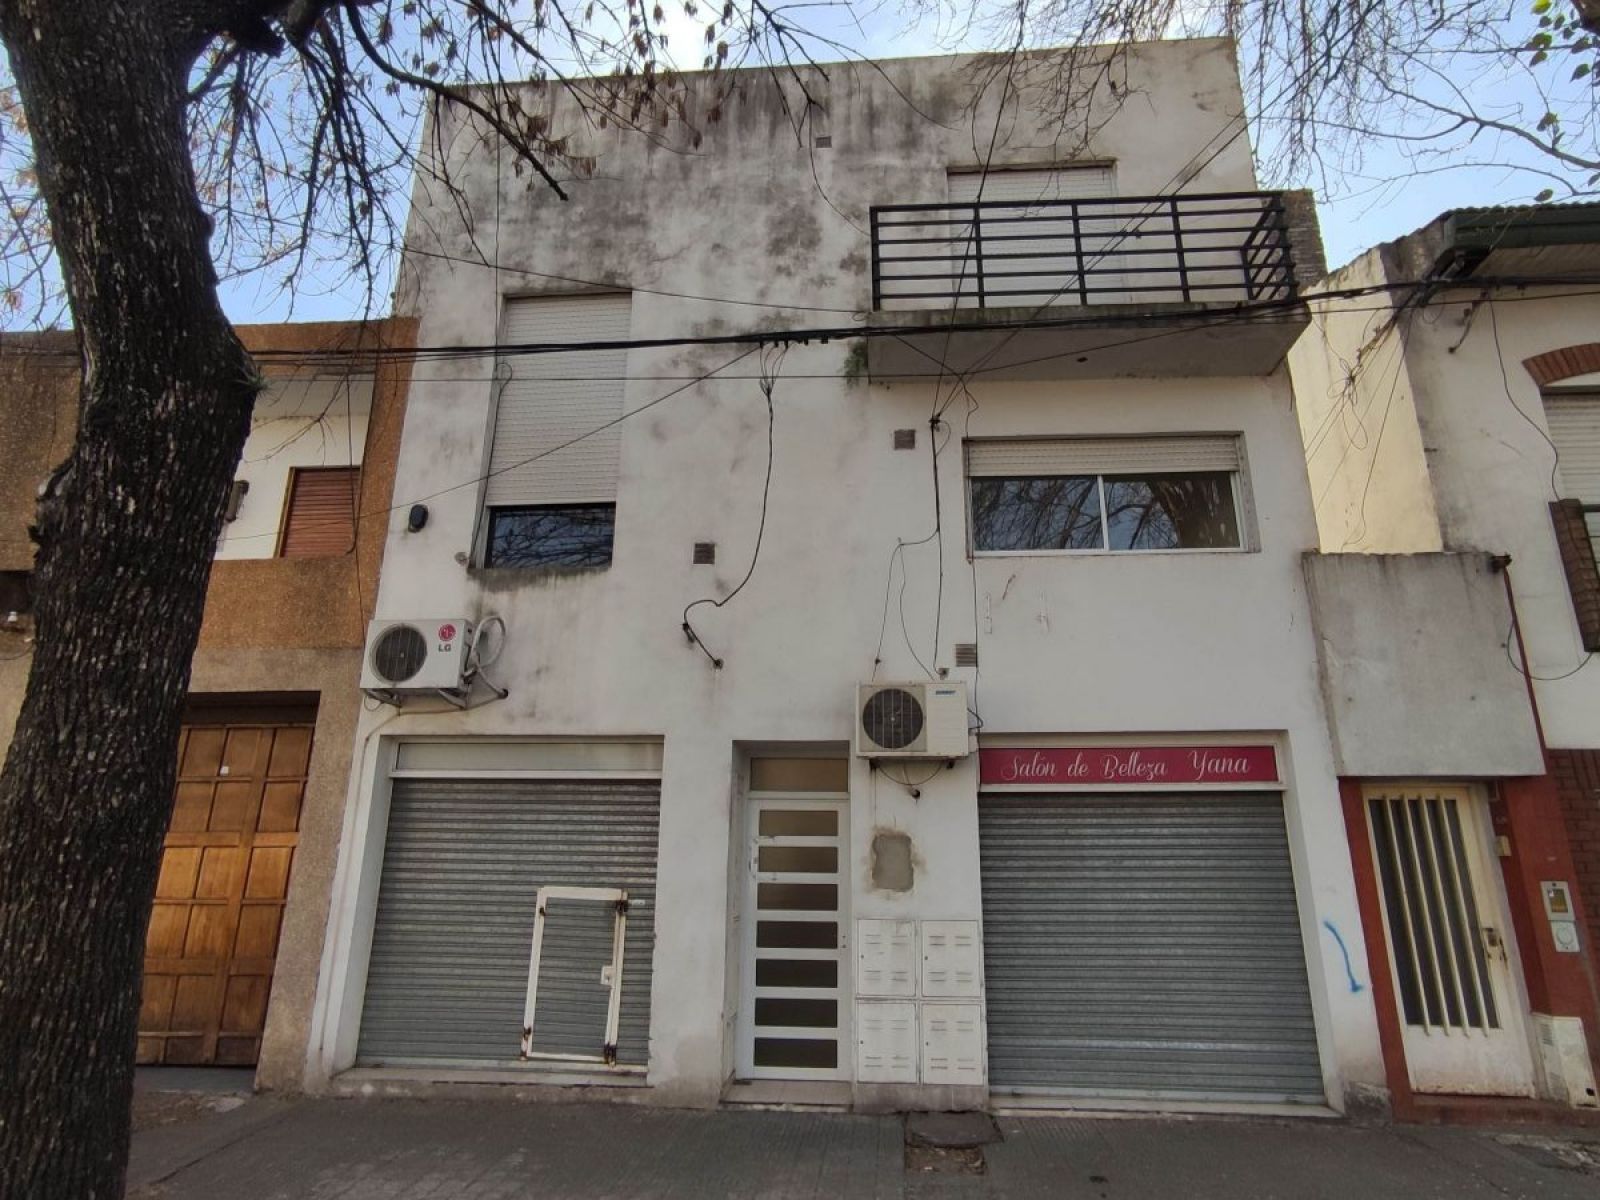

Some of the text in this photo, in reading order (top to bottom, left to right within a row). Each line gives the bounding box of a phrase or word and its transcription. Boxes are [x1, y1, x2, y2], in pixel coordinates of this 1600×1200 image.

[438, 643, 452, 653] LG
[1001, 750, 1249, 781] Salón de Belleza Yana
